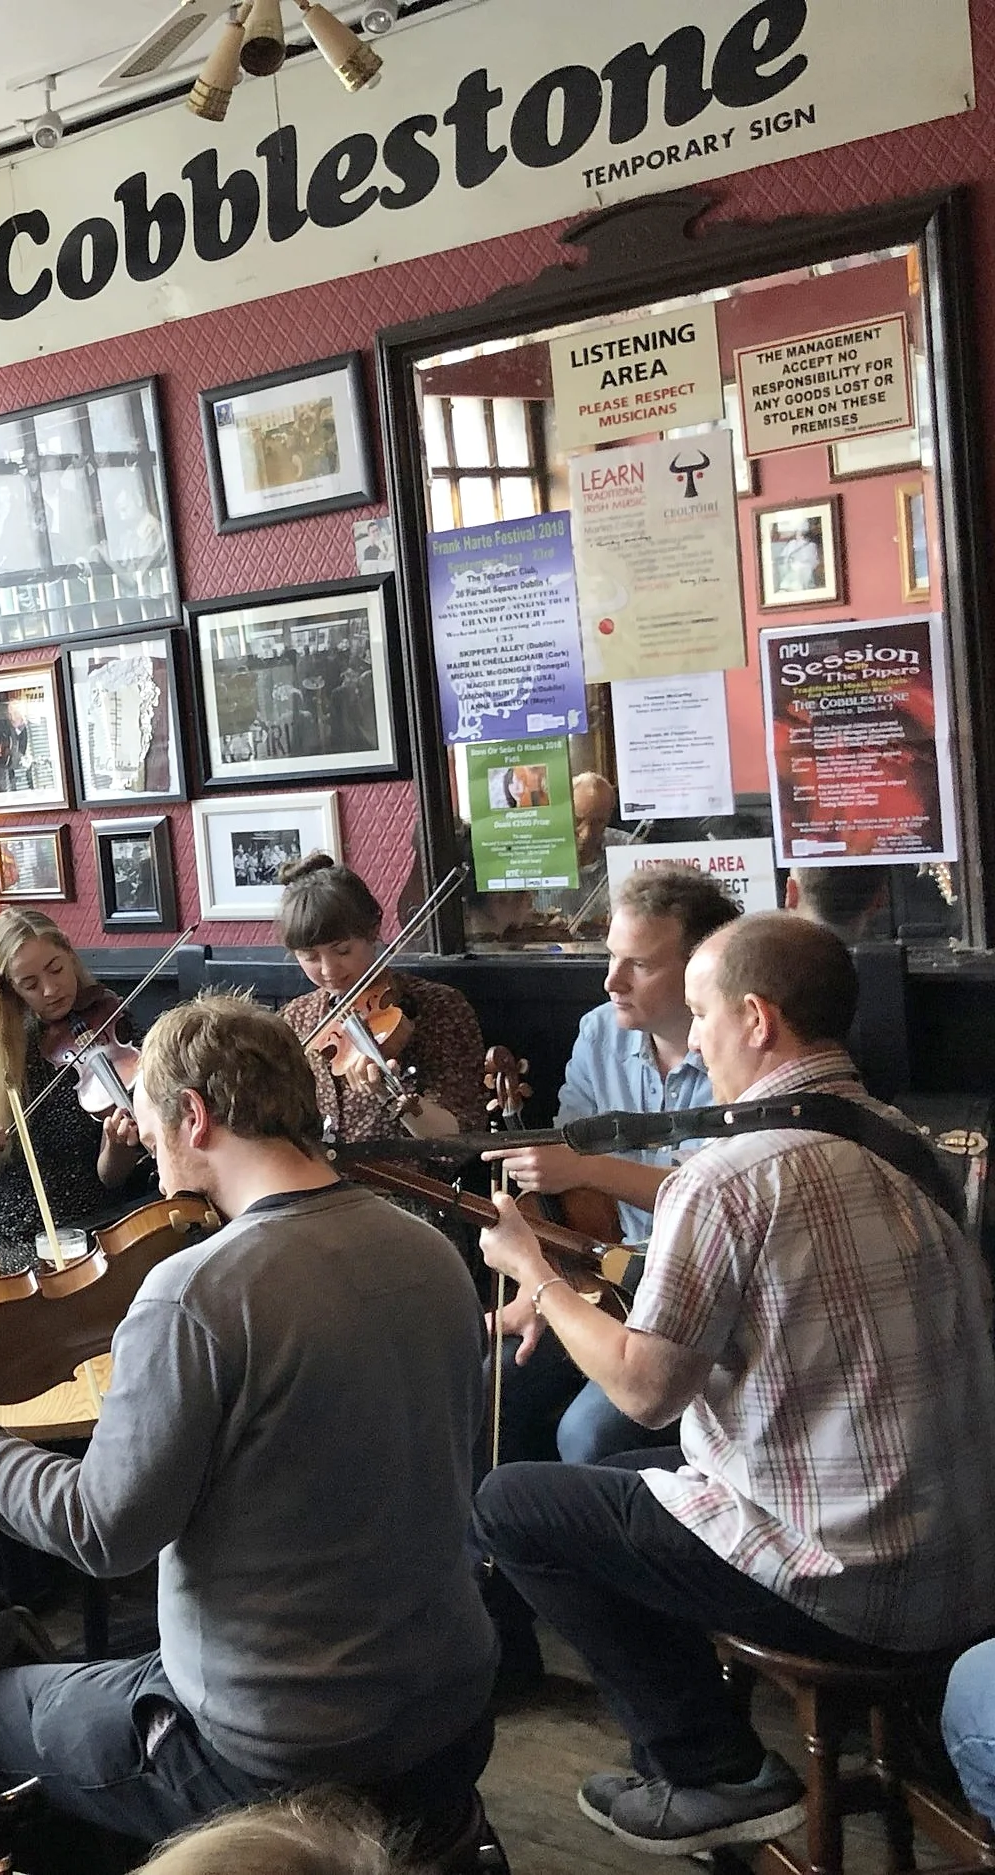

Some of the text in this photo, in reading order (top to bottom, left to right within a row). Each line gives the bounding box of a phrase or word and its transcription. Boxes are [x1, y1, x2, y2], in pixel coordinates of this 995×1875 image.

[582, 103, 816, 190] TEMPORARY SIGN
[570, 322, 696, 368] LISTENING
[757, 327, 882, 364] THE MANAGEMENT
[600, 359, 667, 389] AREA
[752, 358, 893, 396] RESPONSIBILITY FOR
[782, 350, 858, 375] ACCEPT NO
[578, 383, 696, 416] PLEASE RESPECT
[754, 374, 894, 412] ANY GOODS LOST OR
[598, 403, 677, 428] MUSICIANS
[763, 391, 886, 425] STOLEN ON THESE
[792, 413, 858, 435] PREMISES
[581, 462, 644, 491] LEARN
[583, 485, 643, 502] TRADITIONAL
[433, 539, 460, 556] Frank
[464, 534, 492, 549] Harte
[495, 526, 535, 546] Festival
[539, 520, 564, 538] 2018
[467, 573, 480, 582] The
[779, 643, 809, 659] NPU
[781, 644, 919, 686] Session
[451, 671, 483, 680] MICHAEL
[823, 667, 920, 682] The Pipers
[709, 856, 745, 872] AREA
